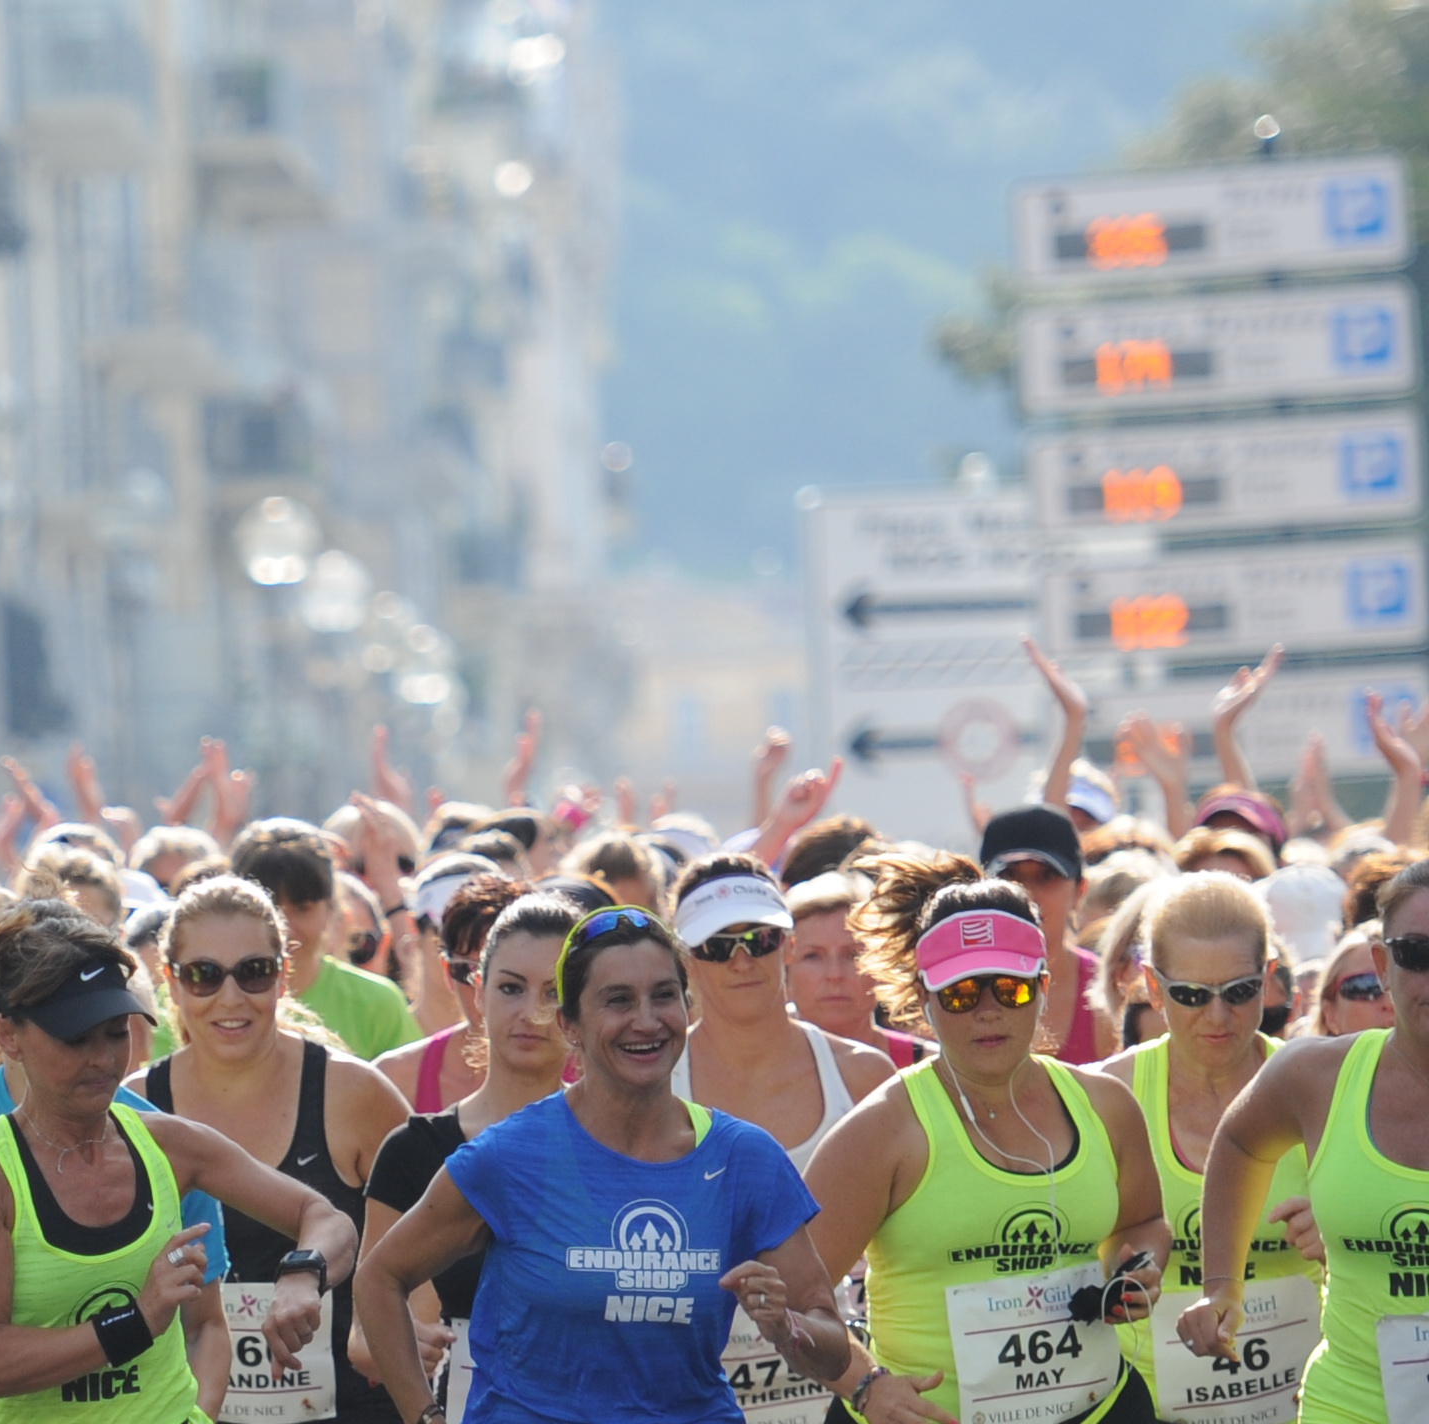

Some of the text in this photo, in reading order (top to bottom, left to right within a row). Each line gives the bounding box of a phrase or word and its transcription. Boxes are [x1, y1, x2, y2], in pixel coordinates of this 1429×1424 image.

[951, 1243, 1094, 1263] ENDURANCE
[1343, 1238, 1429, 1254] ENDUR
[569, 1249, 720, 1271] ENDURANCE
[996, 1256, 1053, 1272] SHOP
[1392, 1253, 1429, 1267] SH
[618, 1270, 686, 1289] SHOP
[1180, 1262, 1255, 1286] NE
[1389, 1272, 1429, 1297] NI
[988, 1284, 1072, 1312] Iron Girl
[1244, 1295, 1278, 1315] Girl
[604, 1295, 695, 1325] NICE
[1018, 1309, 1035, 1318] RUN
[1245, 1313, 1279, 1323] FRANCE
[1415, 1326, 1429, 1342] Ir
[237, 1336, 273, 1367] 6
[998, 1325, 1083, 1368] 464
[61, 1364, 140, 1403] NICE
[227, 1371, 311, 1389] ANDINE
[1016, 1367, 1065, 1390] MAY
[1186, 1368, 1297, 1404] ISABELLE
[737, 1382, 824, 1405] THERIN
[235, 1405, 286, 1416] DE NICE
[989, 1402, 1075, 1424] VILLE DE NICE
[1249, 1407, 1279, 1424] NICE
